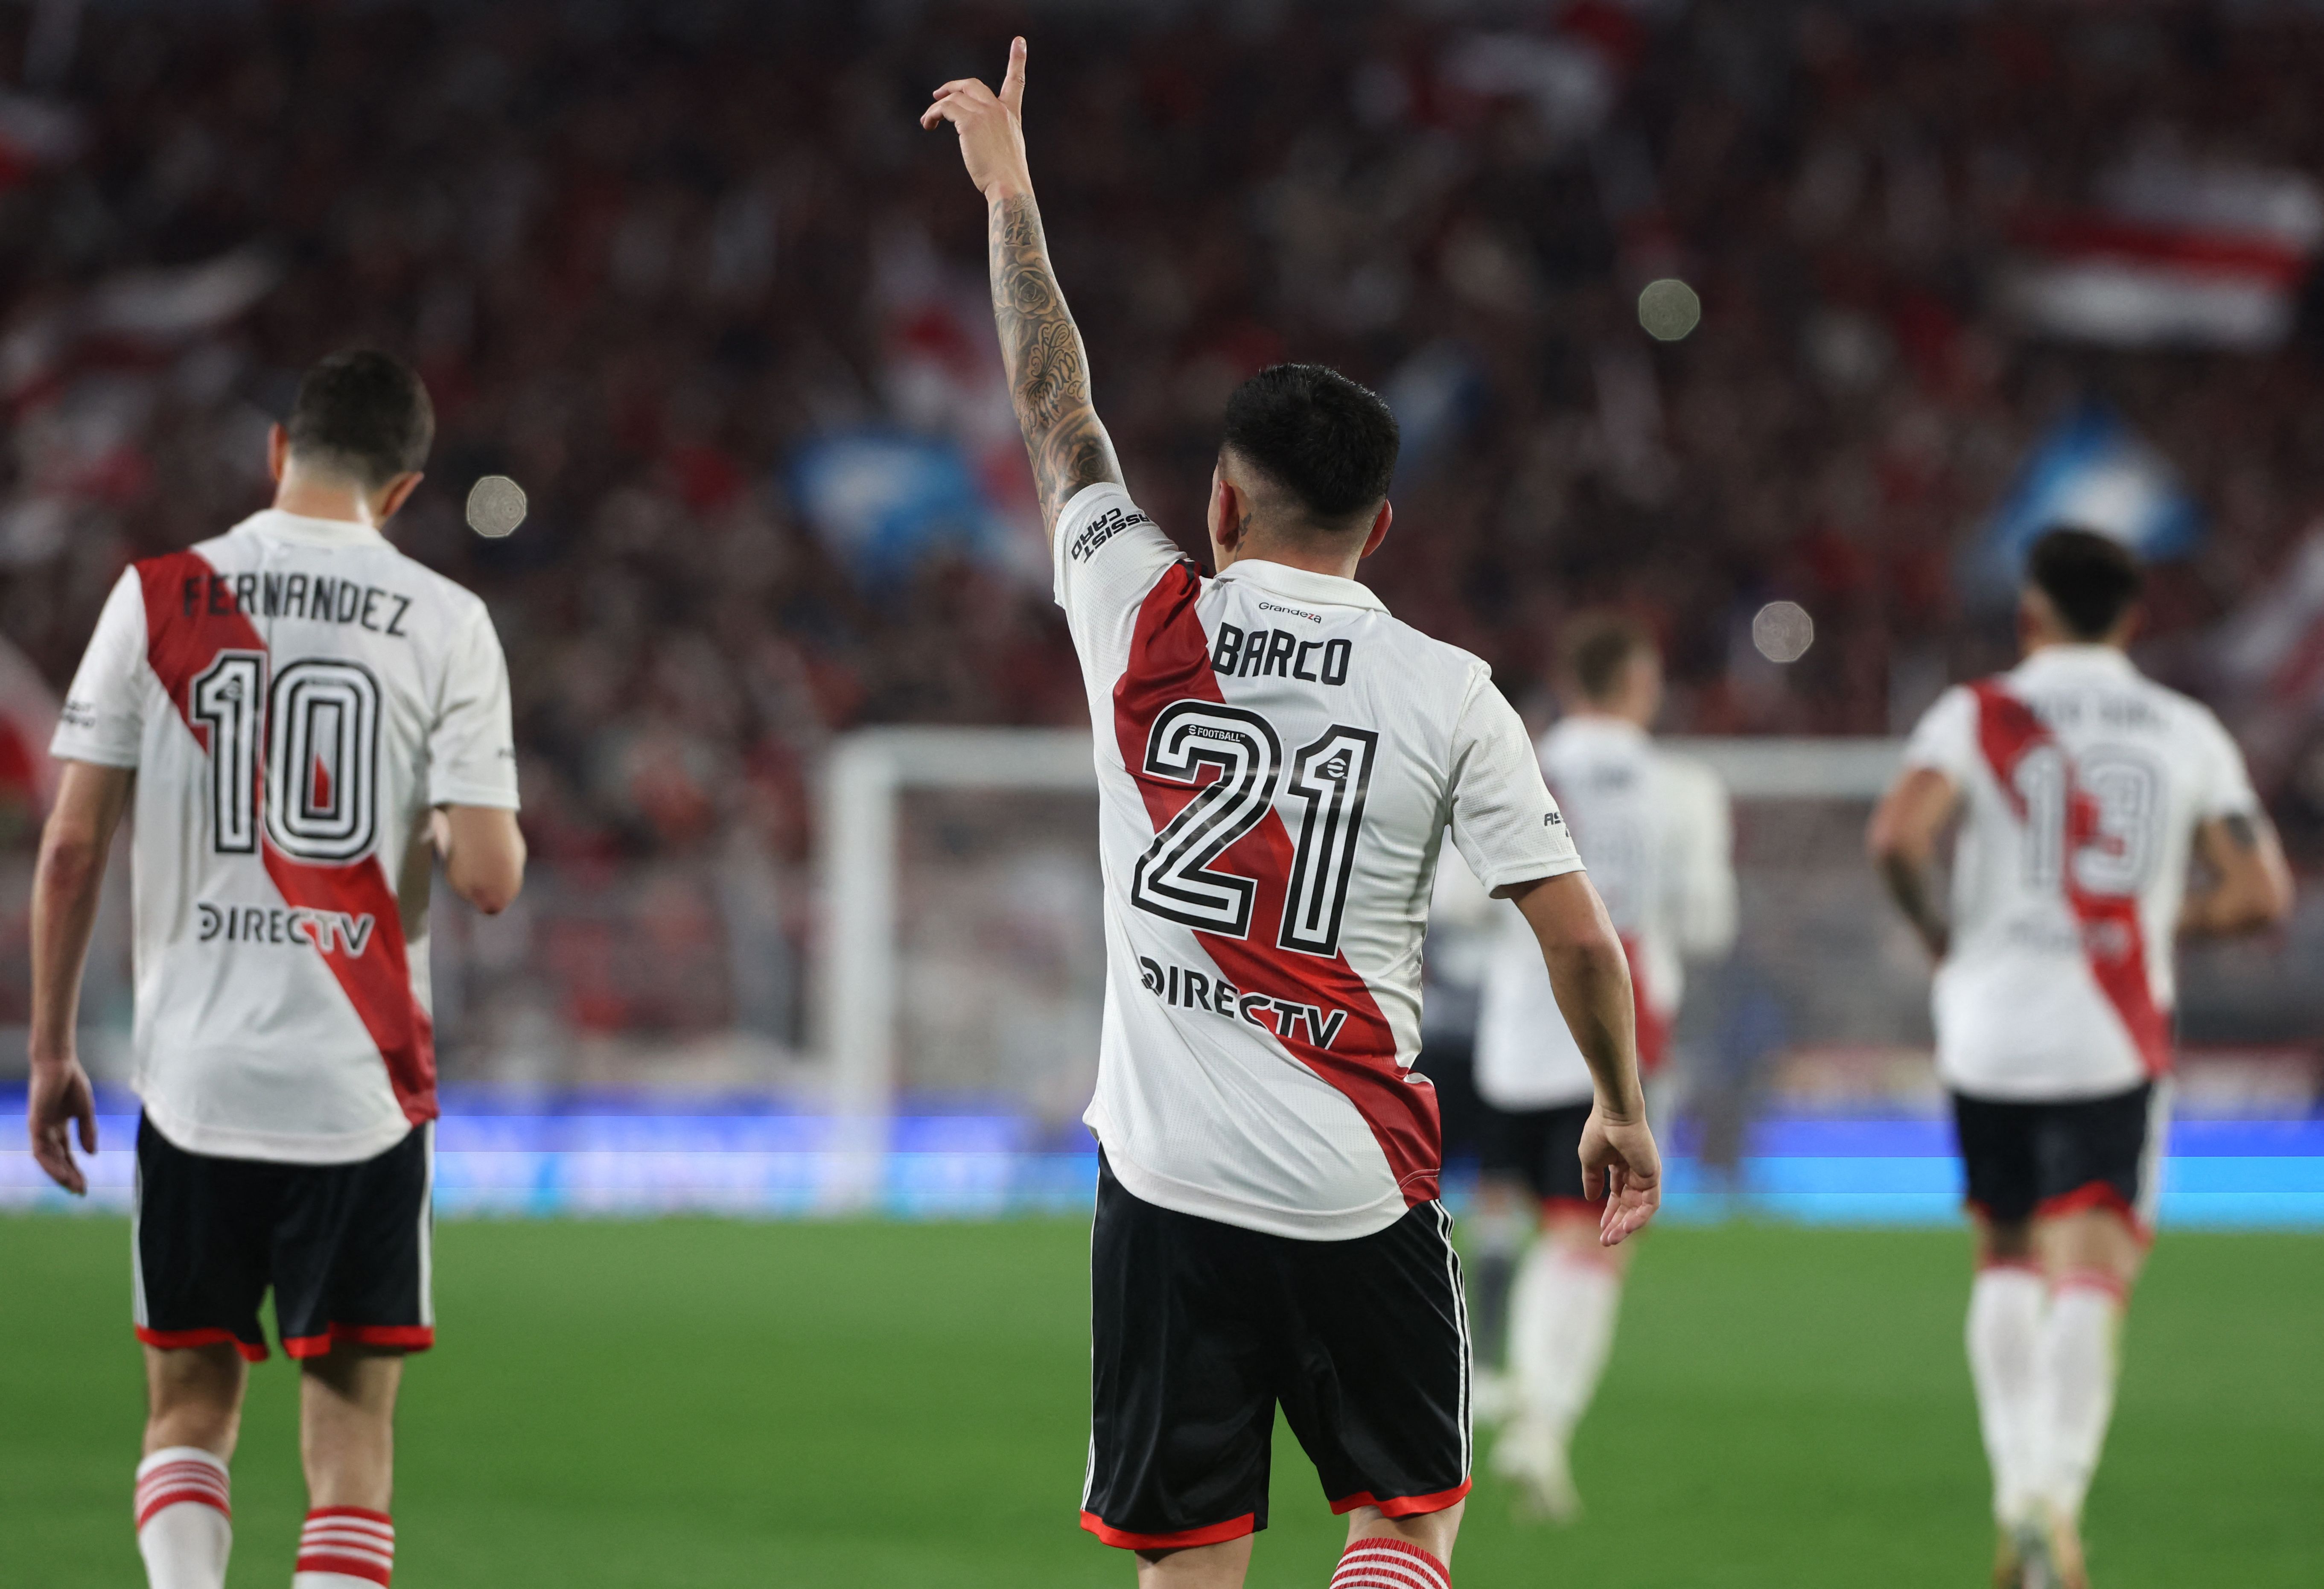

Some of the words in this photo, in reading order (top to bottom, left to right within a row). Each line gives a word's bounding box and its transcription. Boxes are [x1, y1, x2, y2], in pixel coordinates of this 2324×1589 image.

[1071, 508, 1121, 560] CARD
[1084, 513, 1150, 563] ASSIST
[184, 573, 411, 637] FERNANDEZ
[1259, 602, 1321, 624] Grandeza
[1210, 622, 1352, 686] BARCO
[190, 650, 382, 864] 10
[1131, 698, 1379, 959] 21
[198, 903, 373, 956] DIRECTV
[1140, 956, 1348, 1051] DIRECTV
